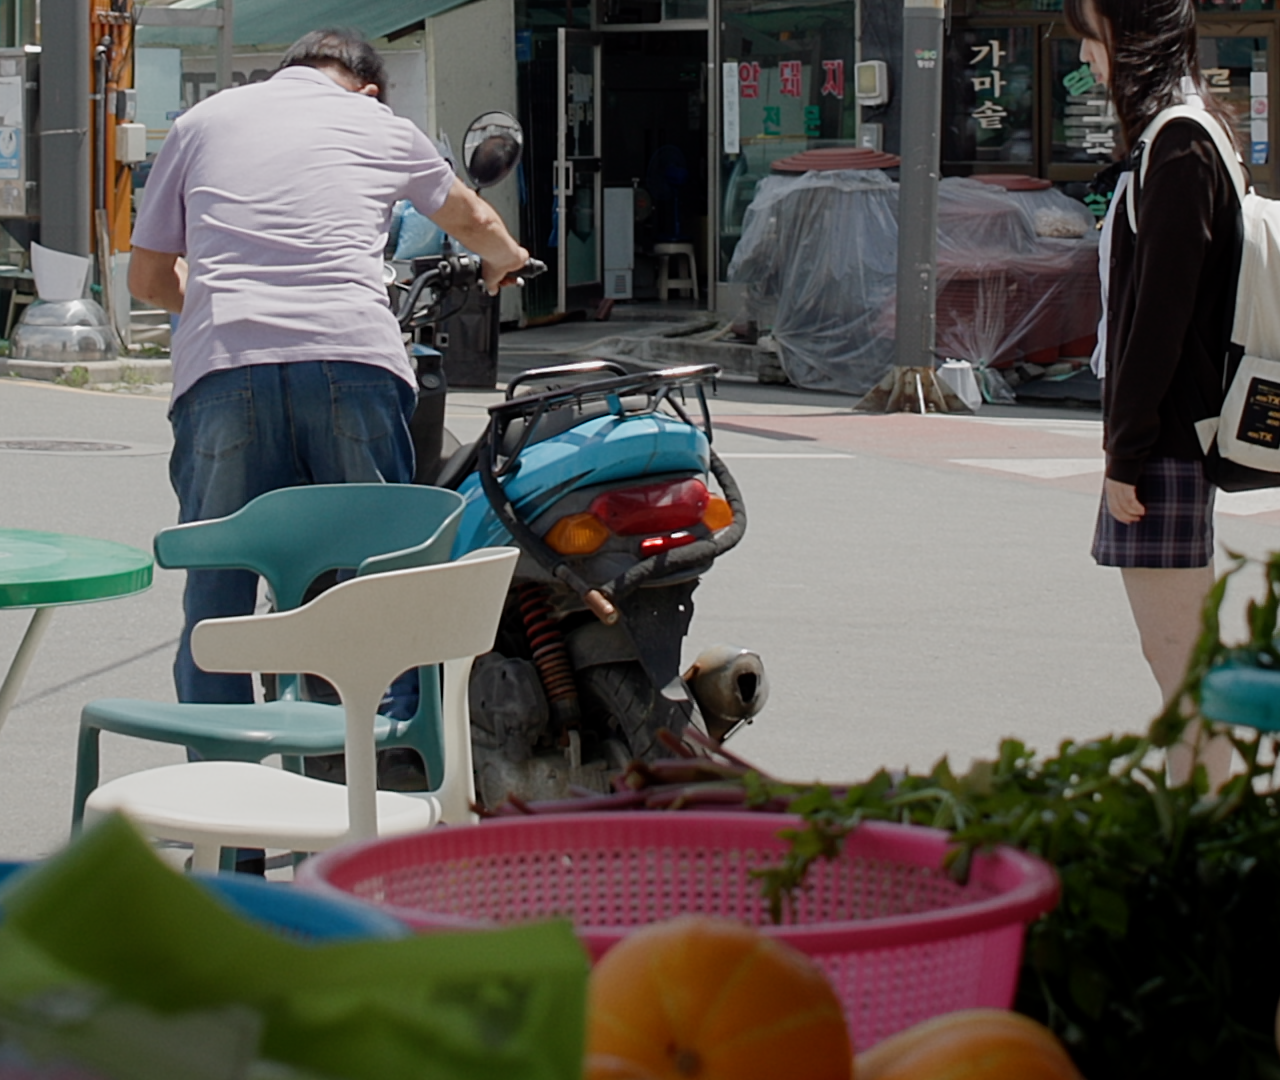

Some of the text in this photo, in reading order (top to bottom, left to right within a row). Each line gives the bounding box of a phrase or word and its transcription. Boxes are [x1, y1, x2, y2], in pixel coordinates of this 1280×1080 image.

[738, 60, 844, 99] 암돼지
[971, 40, 1008, 129] 가마솥
[762, 105, 822, 137] 전문
